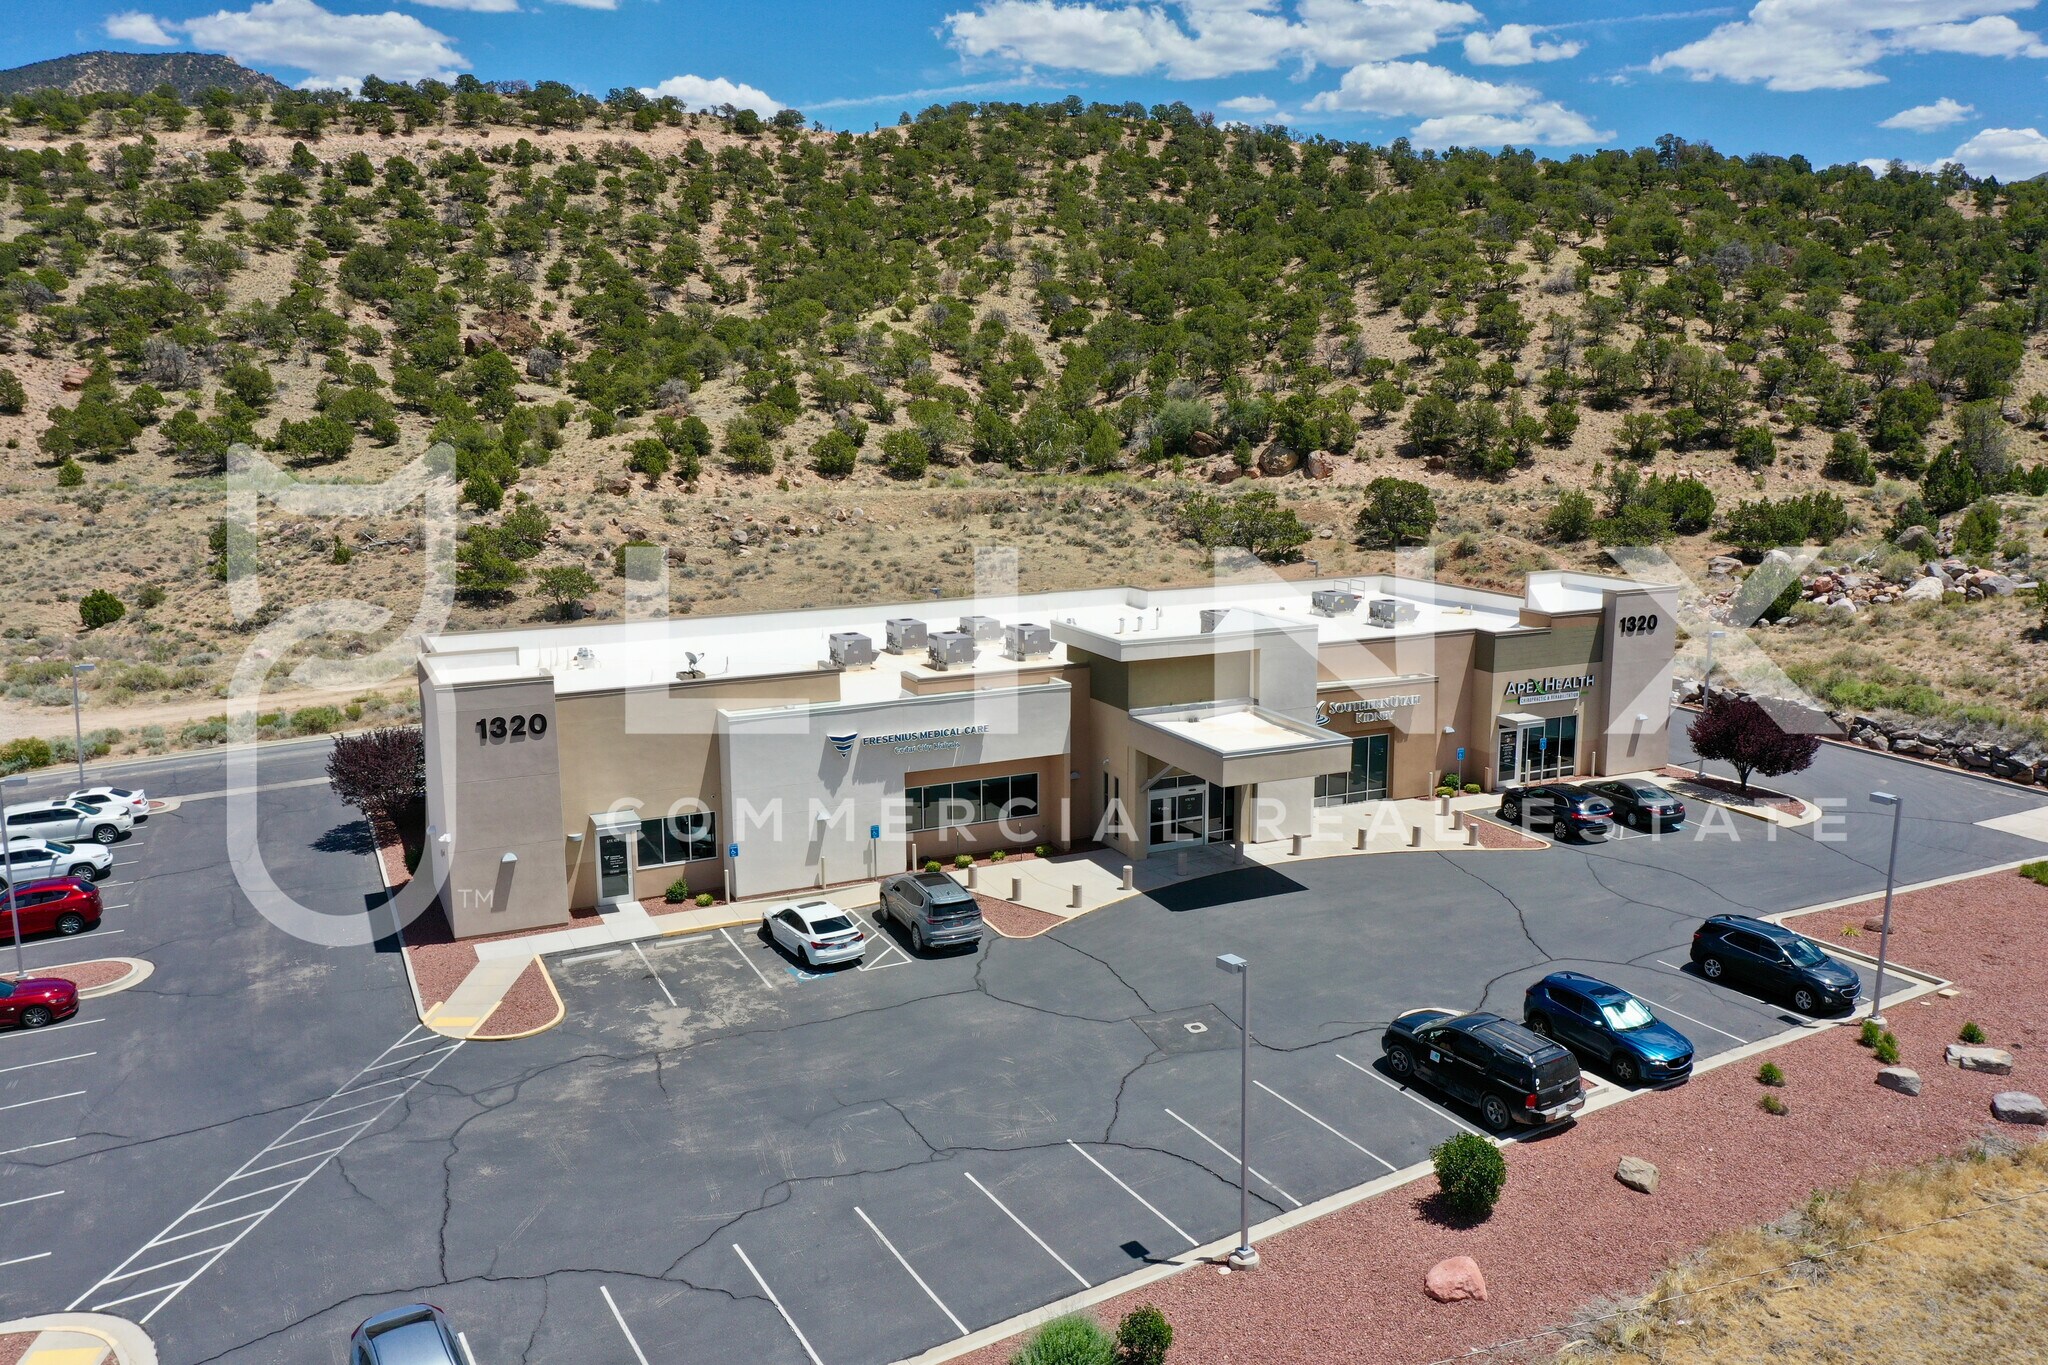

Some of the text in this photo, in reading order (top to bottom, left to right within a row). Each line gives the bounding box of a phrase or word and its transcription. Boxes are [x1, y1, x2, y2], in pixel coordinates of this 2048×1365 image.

[1620, 615, 1658, 633] 1320
[1505, 675, 1595, 696] APEX HEALTH
[1329, 695, 1421, 714] SOUTHERN UTAH
[1520, 695, 1547, 704] CHIROPRACTIC
[476, 713, 548, 739] 1320
[1355, 710, 1395, 724] KIDNEY
[863, 725, 989, 746] FRESENIUS MEDICAL CARE
[917, 743, 932, 753] City
